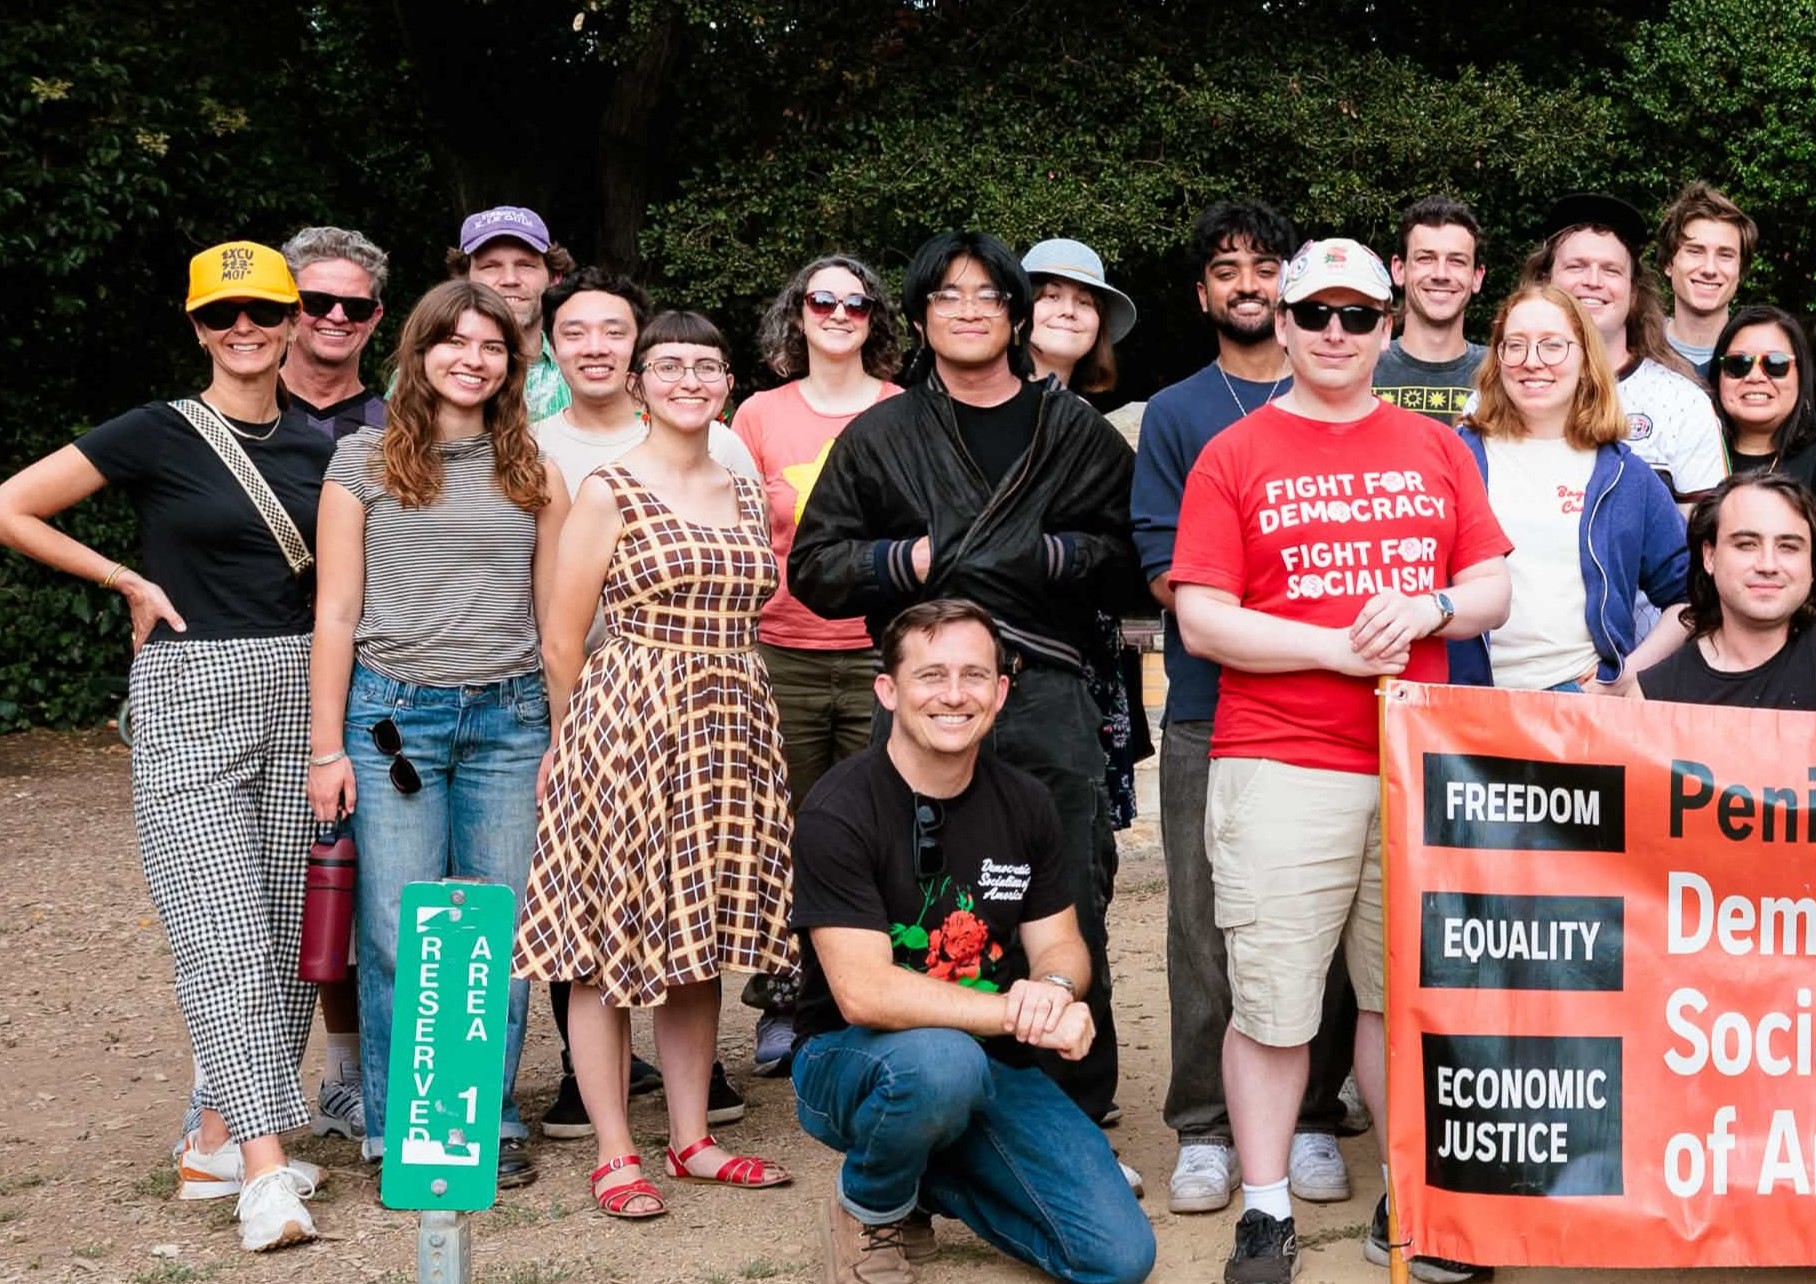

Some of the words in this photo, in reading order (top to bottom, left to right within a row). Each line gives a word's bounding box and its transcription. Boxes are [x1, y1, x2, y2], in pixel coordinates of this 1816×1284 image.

[1265, 474, 1354, 504] FIGHT
[1363, 471, 1425, 494] FOR
[1258, 495, 1446, 535] DEMOCRACY
[1281, 542, 1372, 572] FIGHT
[1380, 537, 1438, 564] FOR
[1286, 566, 1435, 599] SOCIALISM
[1446, 781, 1600, 826] FREEDOM
[981, 857, 1031, 875] Democratic
[1443, 917, 1601, 964] EQUALITY
[465, 936, 492, 1042] AREA
[457, 1086, 478, 1125] 1
[1437, 1066, 1608, 1110] ECONOMIC
[1437, 1119, 1568, 1164] JUSTICE
[1663, 1105, 1737, 1199] of
